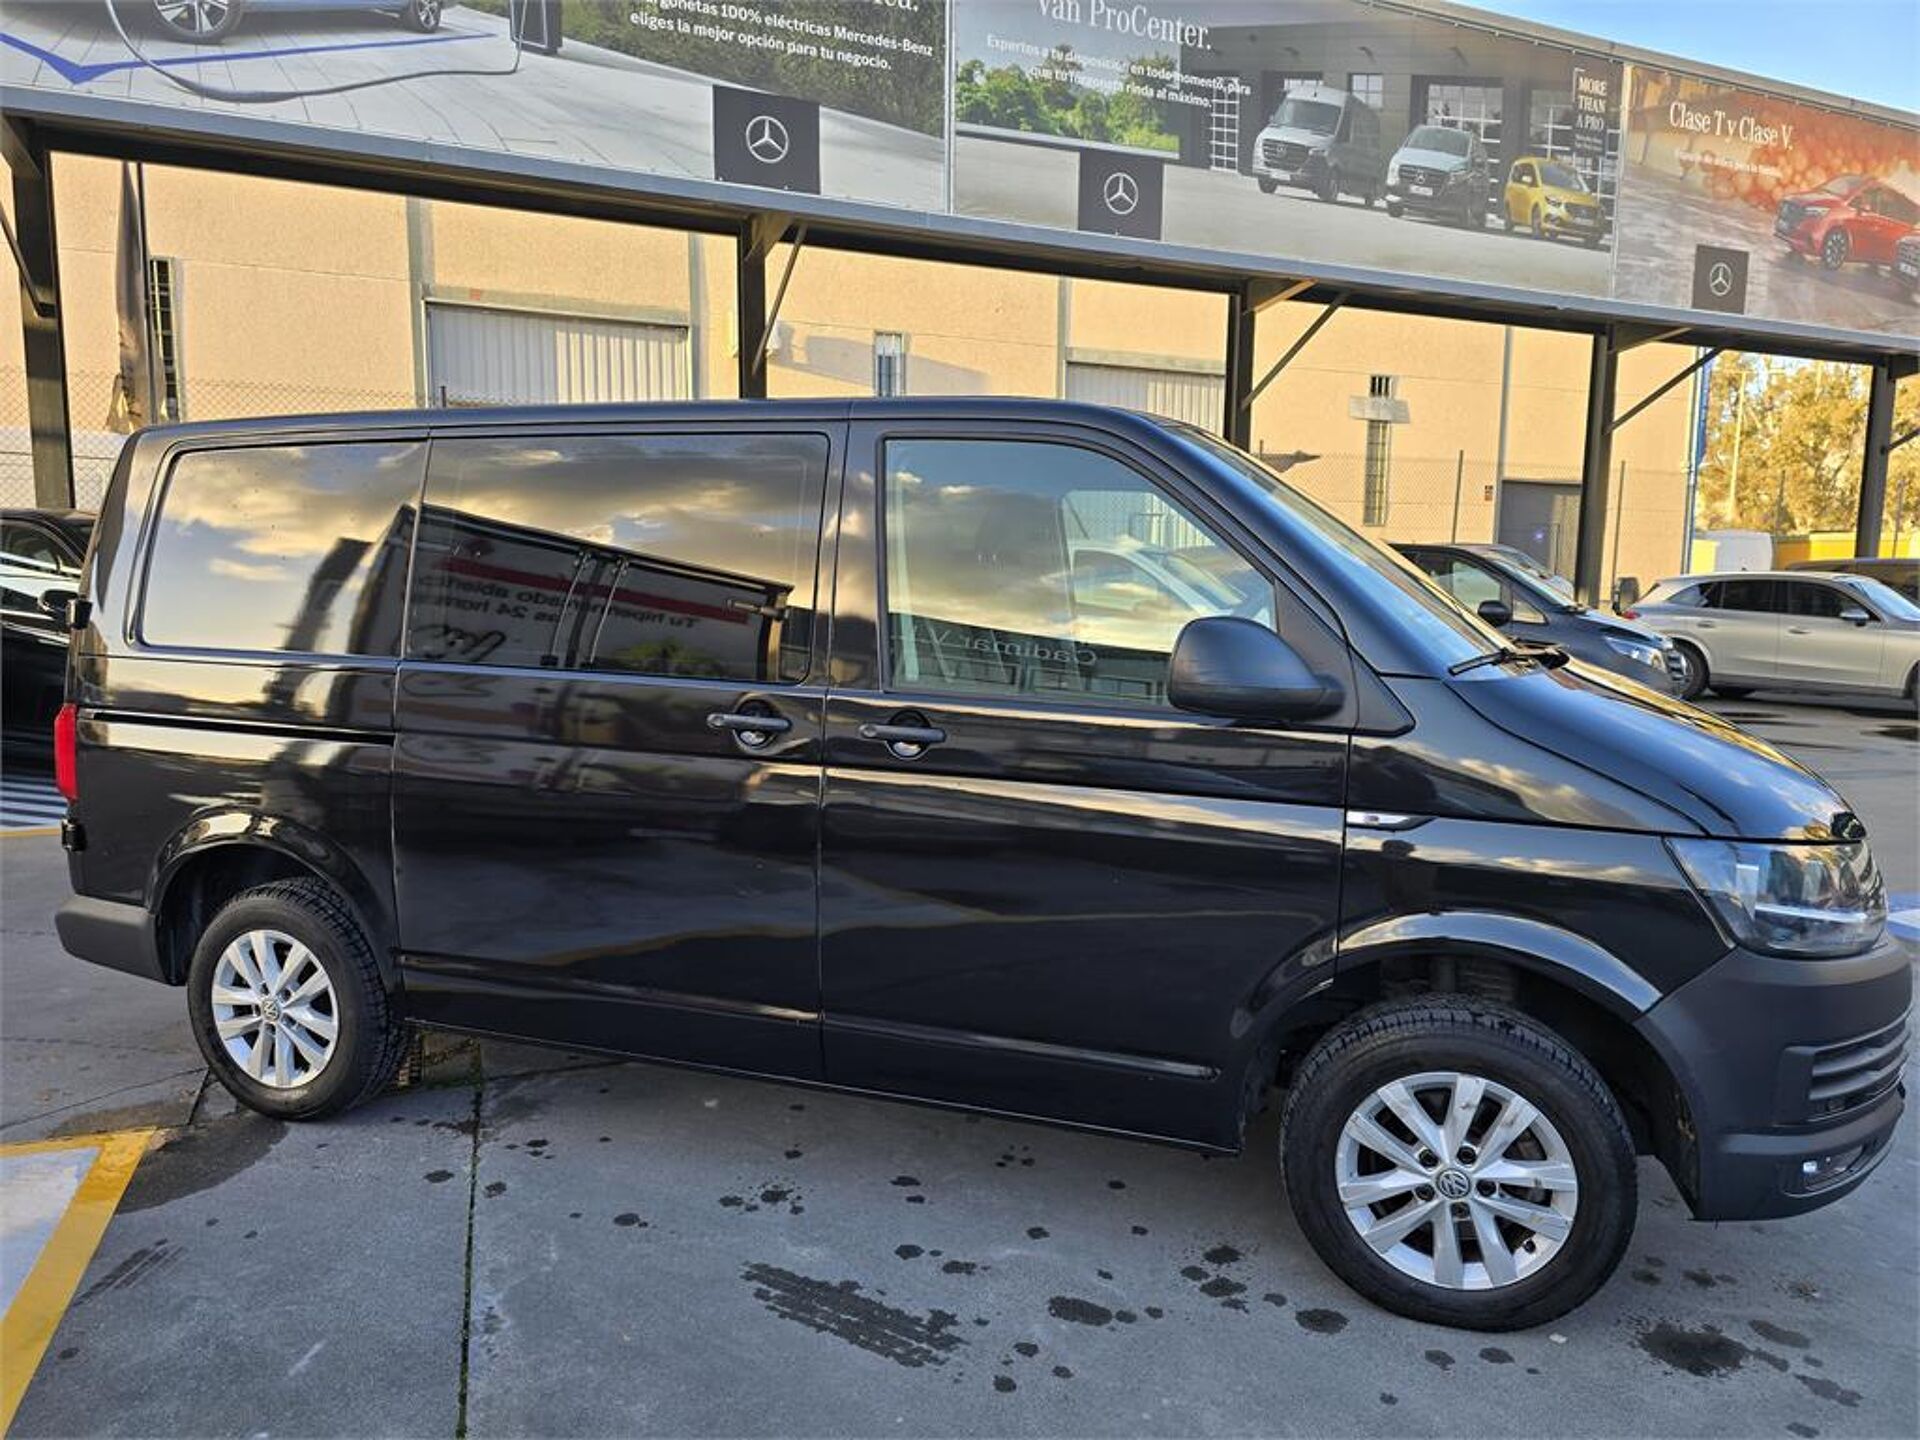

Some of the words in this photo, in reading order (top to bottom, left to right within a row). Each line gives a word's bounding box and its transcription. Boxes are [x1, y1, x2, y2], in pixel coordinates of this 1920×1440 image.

[630, 11, 674, 31] eliges
[678, 18, 691, 33] la
[693, 23, 736, 42] mejor
[737, 32, 784, 51] opción
[787, 41, 817, 56] para
[820, 46, 834, 60] tu
[837, 51, 892, 70] negocio.
[721, 4, 762, 24] 100%
[764, 14, 831, 37] eléctricas
[834, 25, 933, 57] Mercedes-Benz
[1090, 0, 1211, 50] ProCenter.
[1051, 48, 1064, 61] tu
[1130, 64, 1145, 76] en
[1147, 65, 1172, 81] todo
[1227, 81, 1251, 95] para
[1126, 82, 1154, 98] rinda
[1156, 87, 1168, 100] al
[1579, 76, 1607, 96] MORE
[1584, 114, 1604, 132] PRO
[1670, 101, 1711, 134] Clase
[1713, 110, 1726, 136] T
[1725, 119, 1737, 143] y
[1740, 116, 1778, 146] Clase
[1782, 124, 1794, 150] V.
